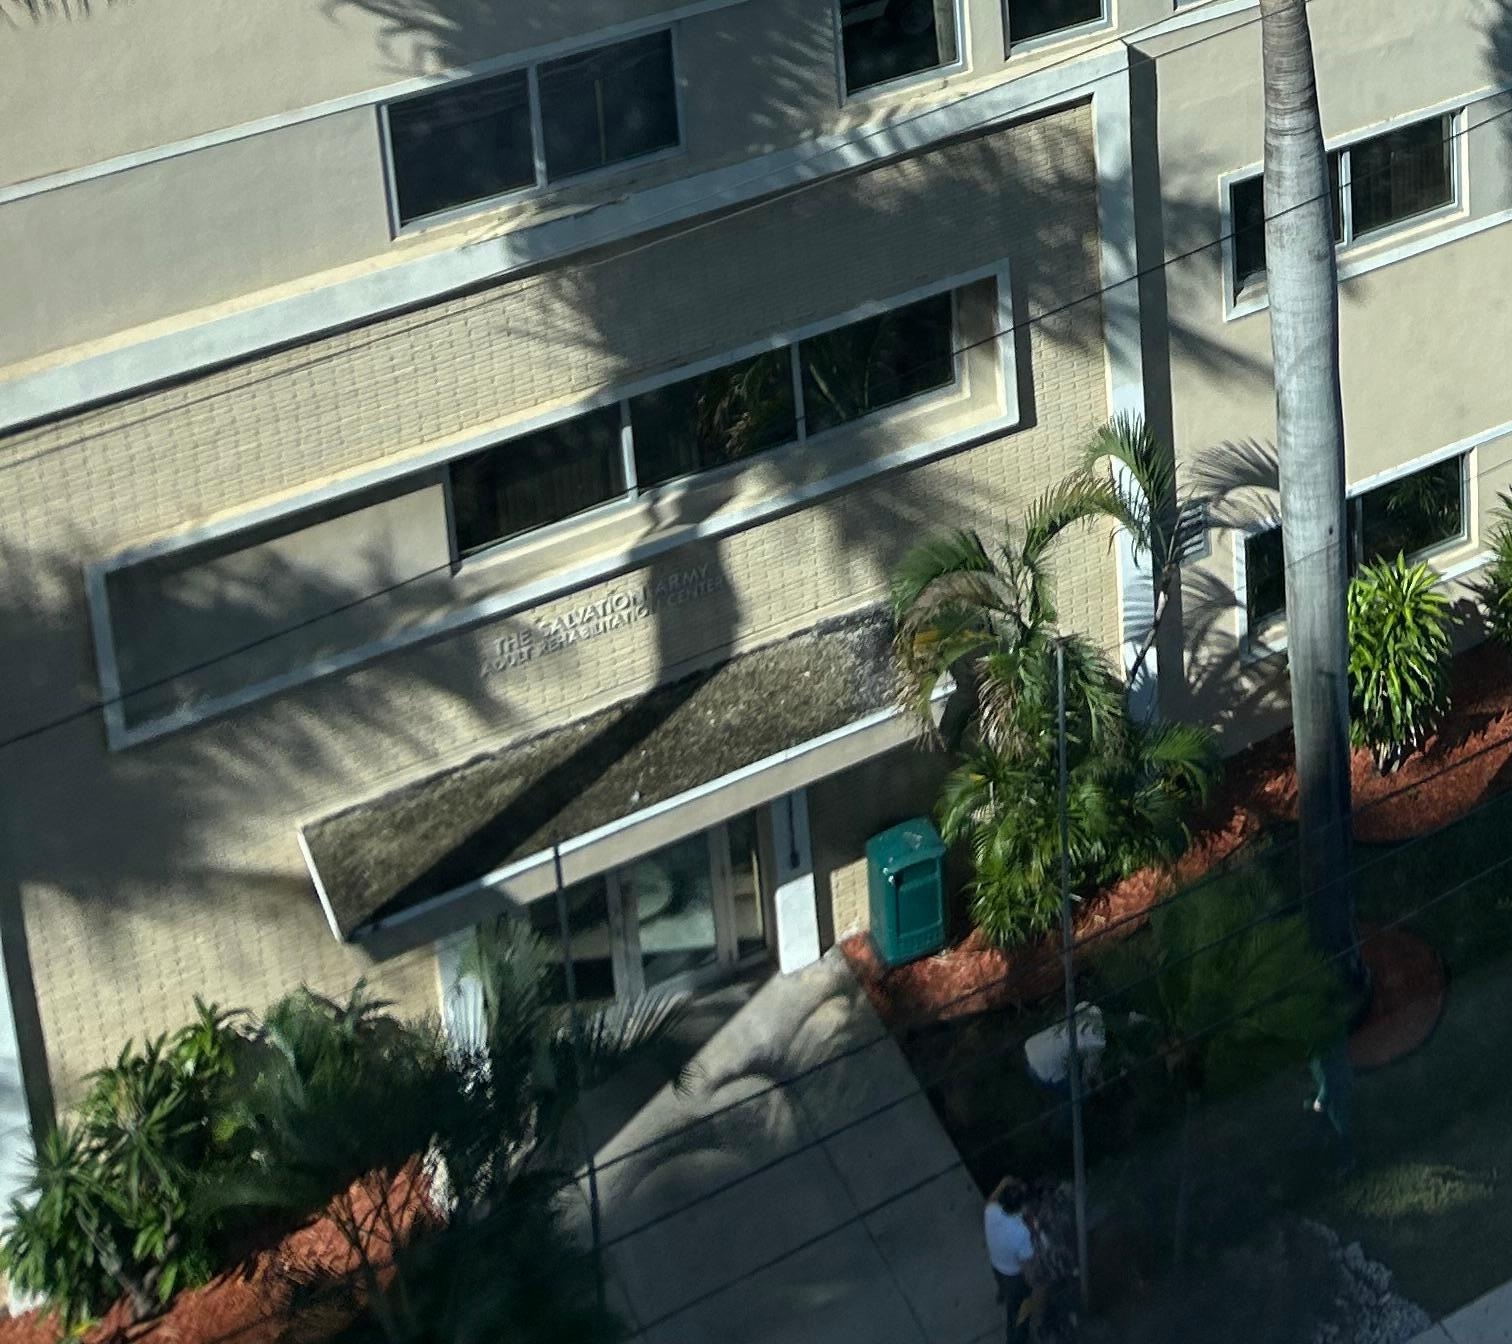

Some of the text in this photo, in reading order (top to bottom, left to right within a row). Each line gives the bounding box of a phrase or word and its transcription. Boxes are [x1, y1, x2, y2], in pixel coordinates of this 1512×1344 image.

[480, 577, 722, 678] ADULT REHABILITATION CENTER
[495, 563, 708, 656] THE SALVATION ARMY
